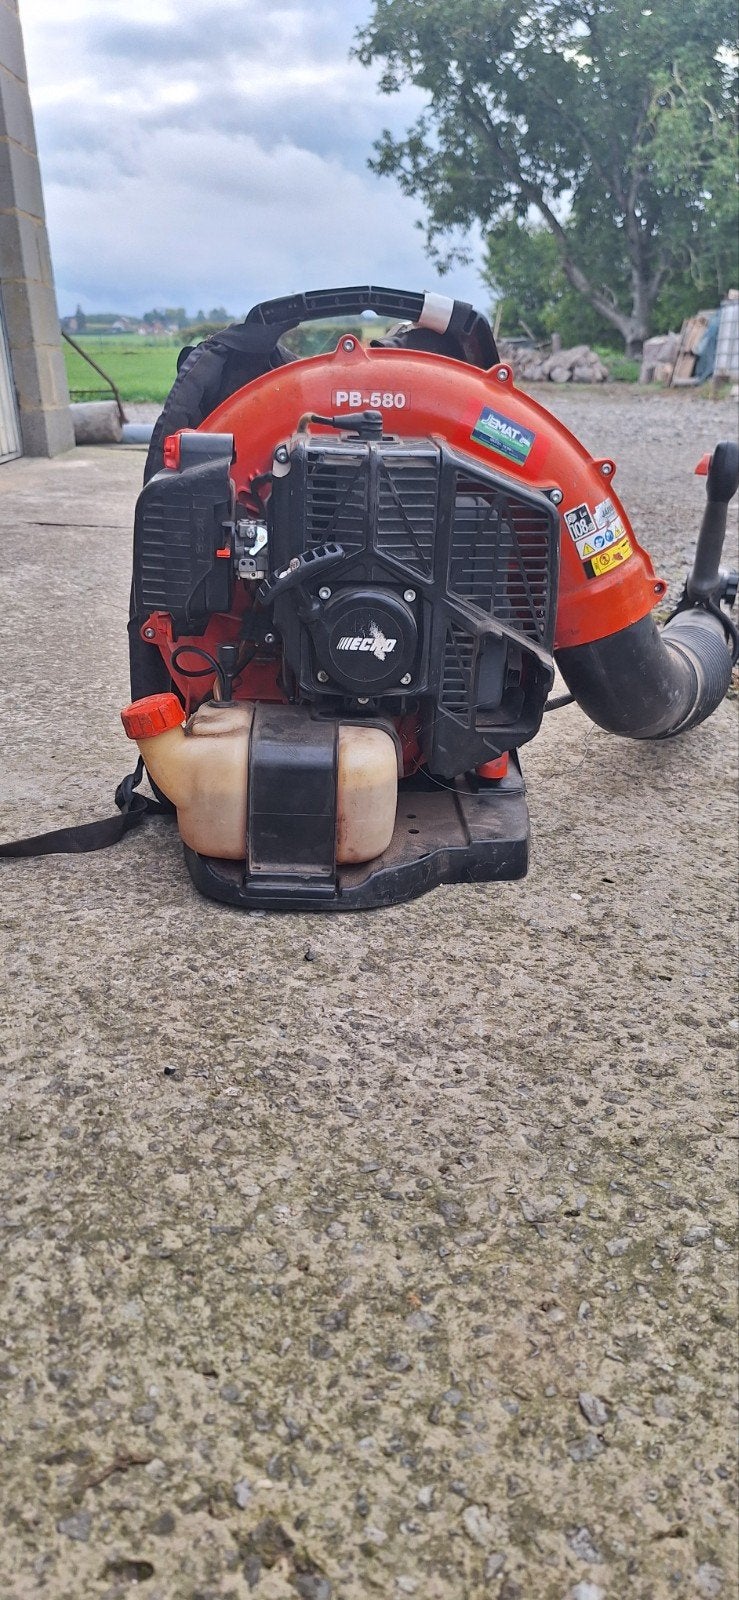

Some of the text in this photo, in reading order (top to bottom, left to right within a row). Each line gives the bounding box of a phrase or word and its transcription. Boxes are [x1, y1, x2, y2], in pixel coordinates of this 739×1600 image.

[336, 391, 406, 409] PB-580
[480, 414, 521, 440] JEMAT
[569, 518, 589, 538] 108
